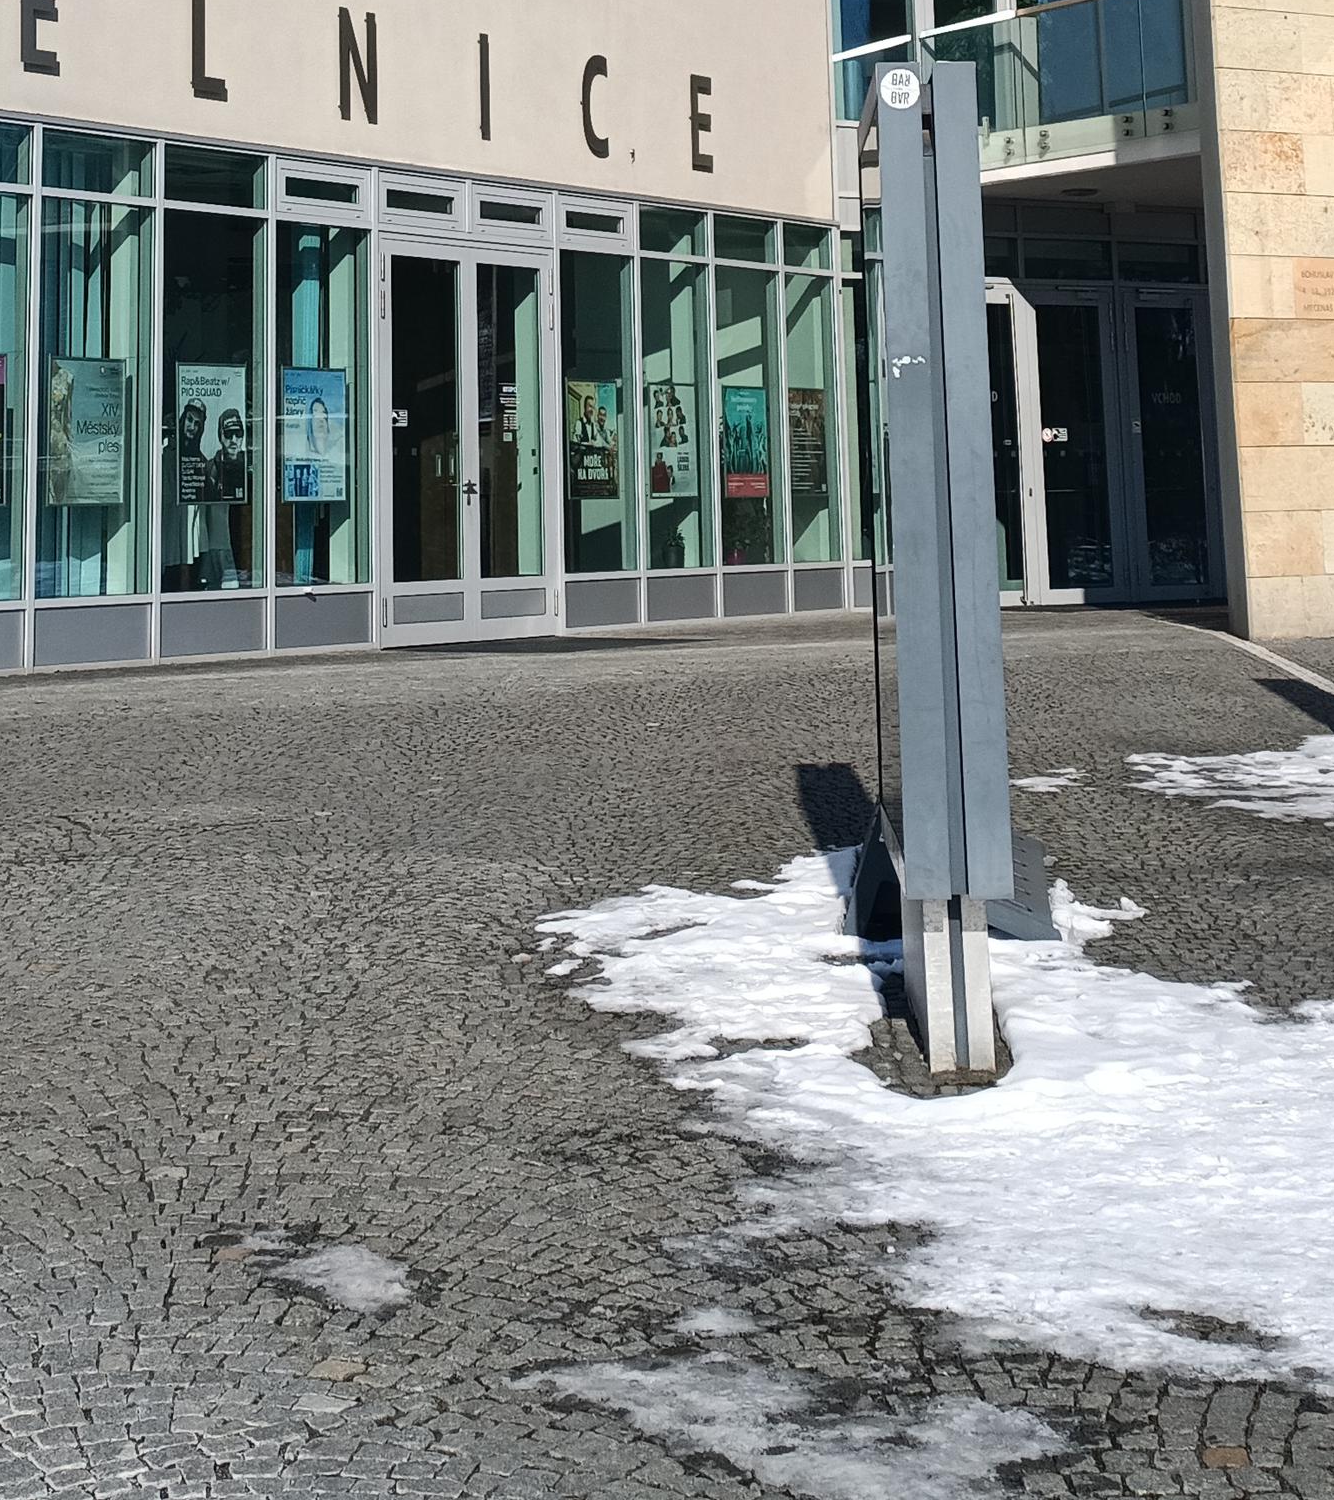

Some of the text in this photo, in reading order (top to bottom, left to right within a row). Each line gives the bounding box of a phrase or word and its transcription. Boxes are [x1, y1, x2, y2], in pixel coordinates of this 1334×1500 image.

[195, 387, 222, 397] SQUAD
[77, 420, 120, 438] Městský
[99, 439, 120, 454] ples
